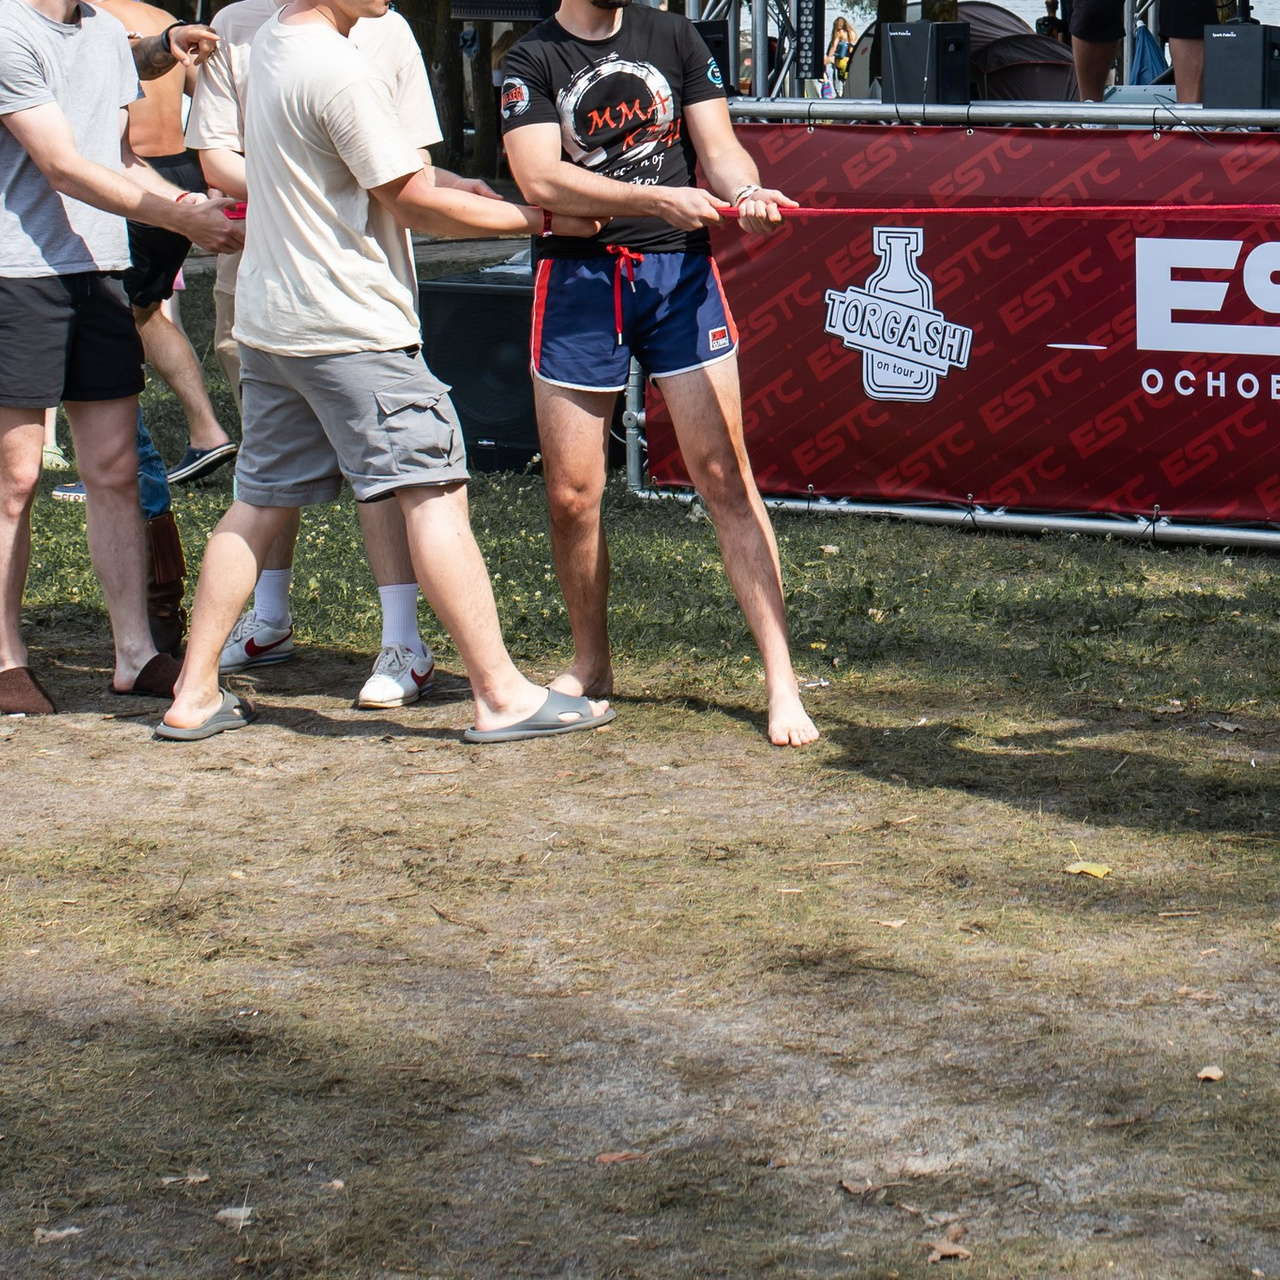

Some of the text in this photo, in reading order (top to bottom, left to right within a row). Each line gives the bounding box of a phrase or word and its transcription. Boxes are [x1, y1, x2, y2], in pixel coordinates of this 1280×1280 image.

[928, 132, 1033, 208] ESTC
[933, 225, 1012, 302] STC
[998, 247, 1103, 335] ESTC
[828, 292, 970, 365] TORGASHI
[744, 370, 803, 433] STC
[876, 359, 915, 379] on tour
[978, 350, 1082, 435] ESTC
[792, 401, 890, 476] ESTC
[876, 420, 976, 497] ESTC
[1159, 402, 1267, 488] ESTC
[62, 493, 87, 501] croc
